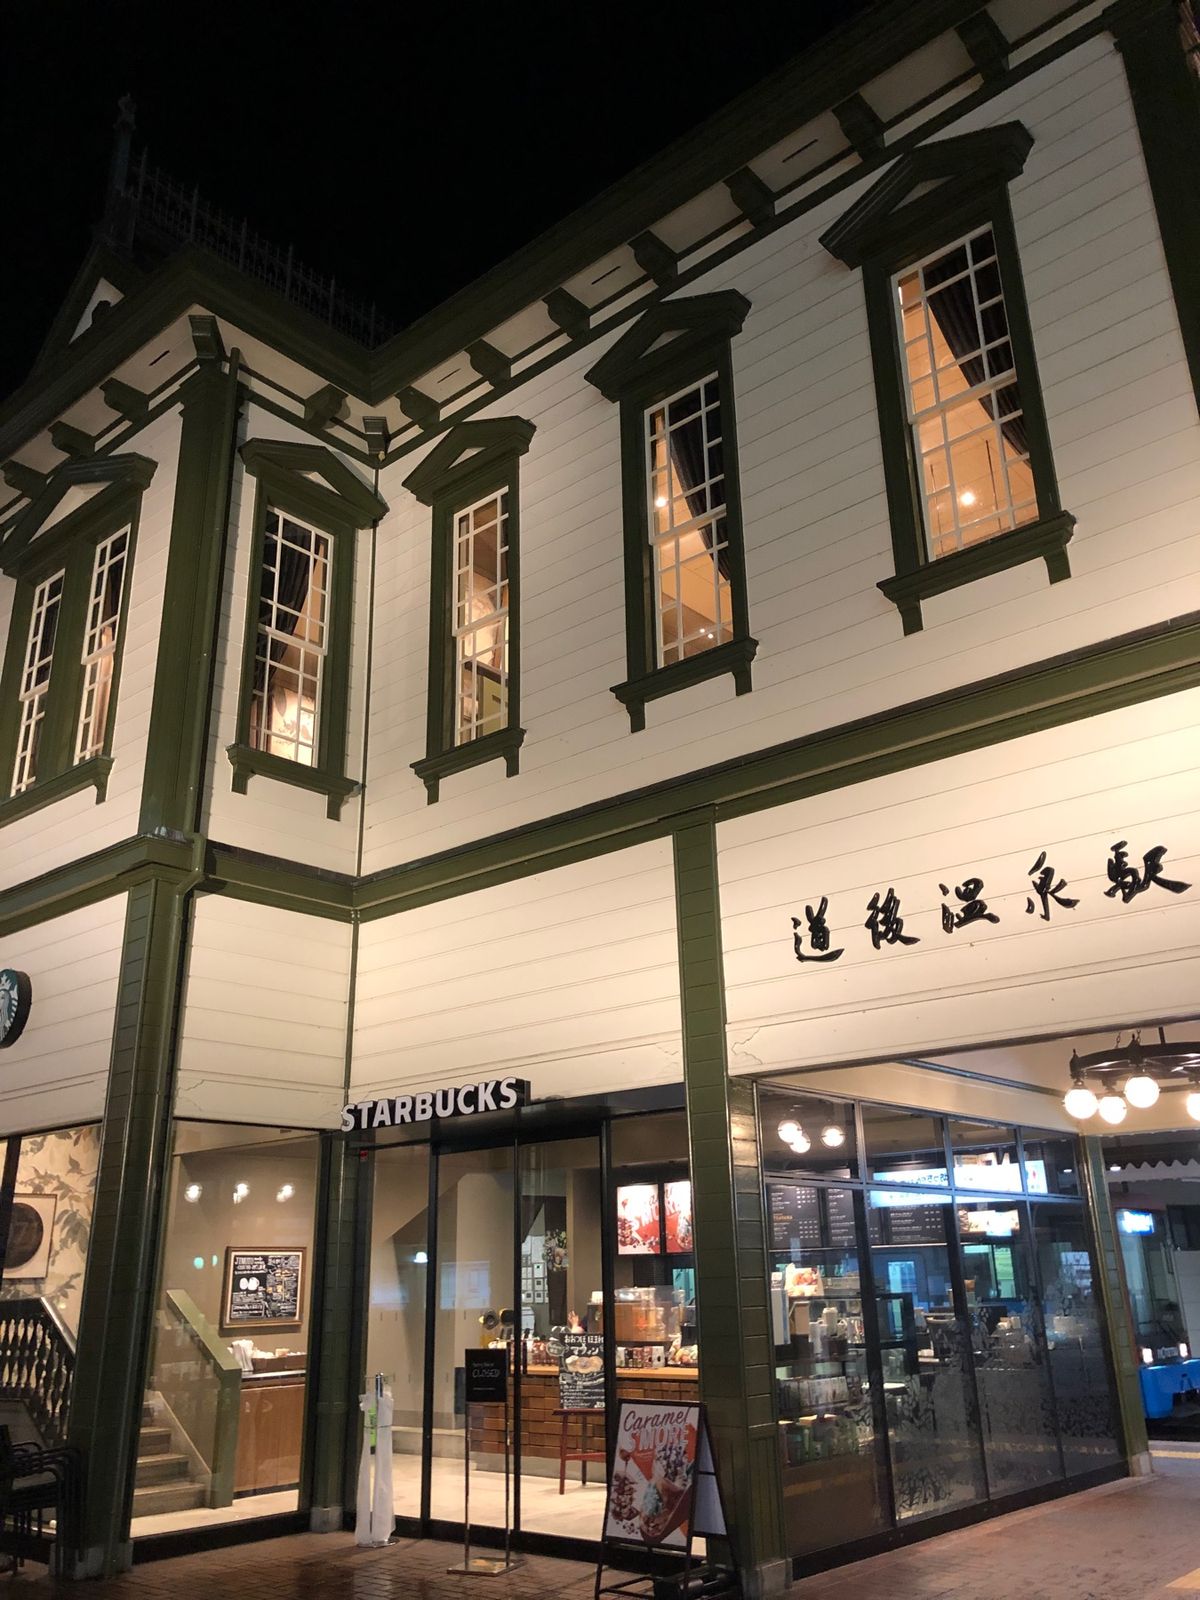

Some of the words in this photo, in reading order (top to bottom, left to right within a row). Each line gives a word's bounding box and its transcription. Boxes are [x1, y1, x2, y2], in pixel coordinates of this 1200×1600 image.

[791, 840, 1193, 963] 道後温泉駅
[340, 1076, 520, 1133] STARBUCKS
[623, 1406, 691, 1432] Caramel
